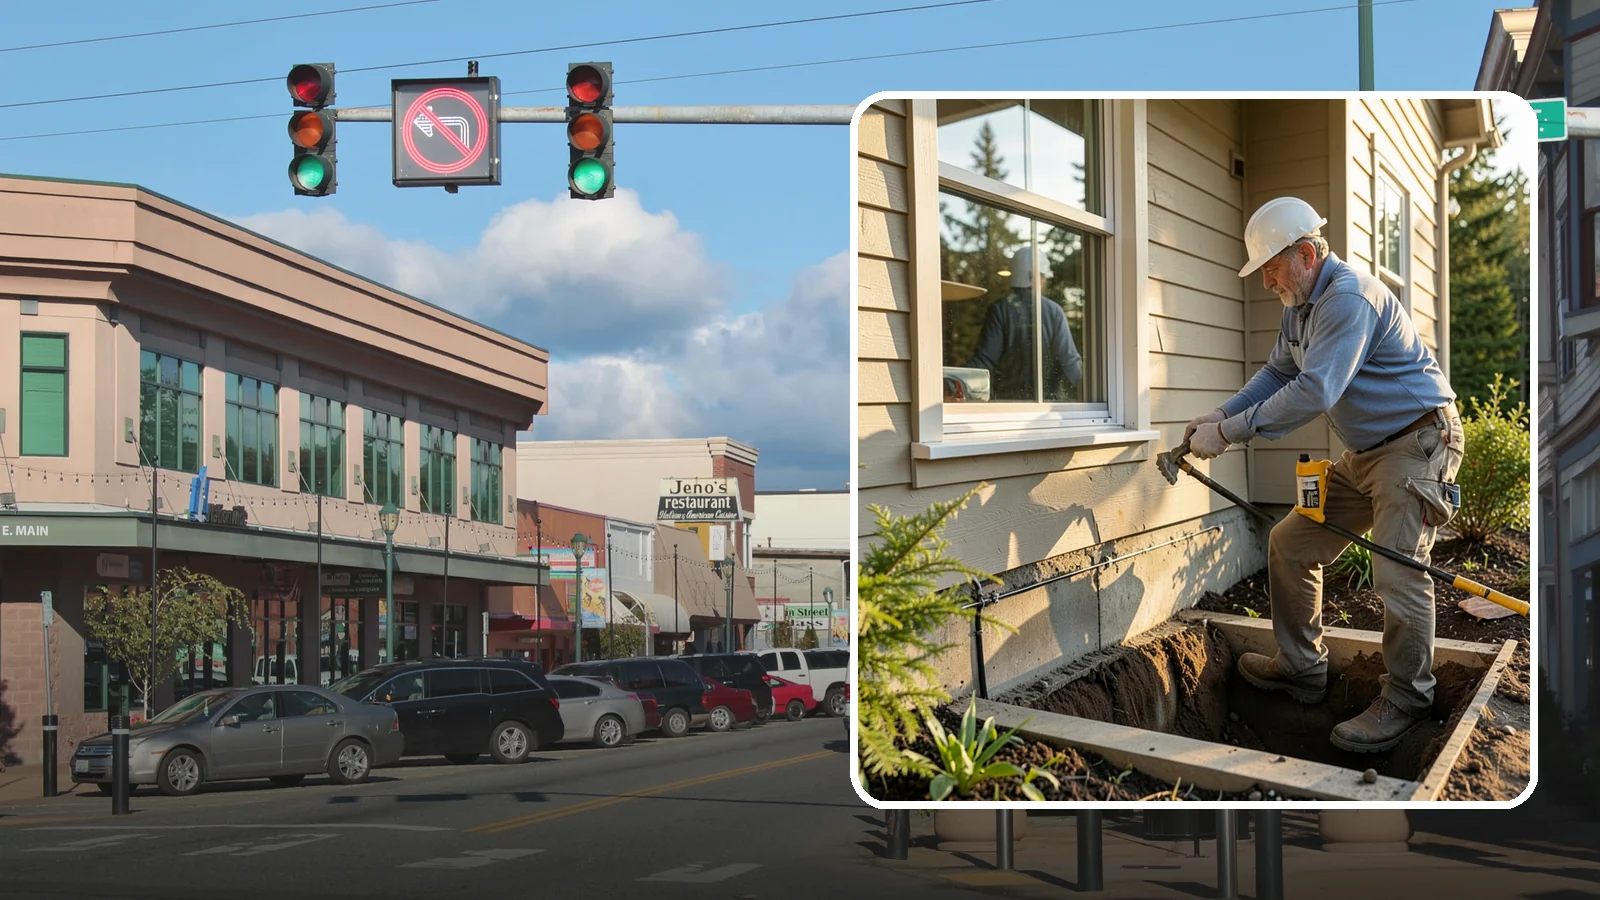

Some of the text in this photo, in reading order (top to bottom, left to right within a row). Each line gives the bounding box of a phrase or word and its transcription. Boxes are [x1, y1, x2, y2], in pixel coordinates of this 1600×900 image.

[669, 480, 727, 494] Jeno's
[665, 496, 731, 509] restaurant
[658, 510, 681, 519] Italian
[686, 510, 714, 519] American
[715, 509, 737, 519] Cuisine
[2, 525, 49, 537] E. MAIN
[797, 608, 828, 616] Street
